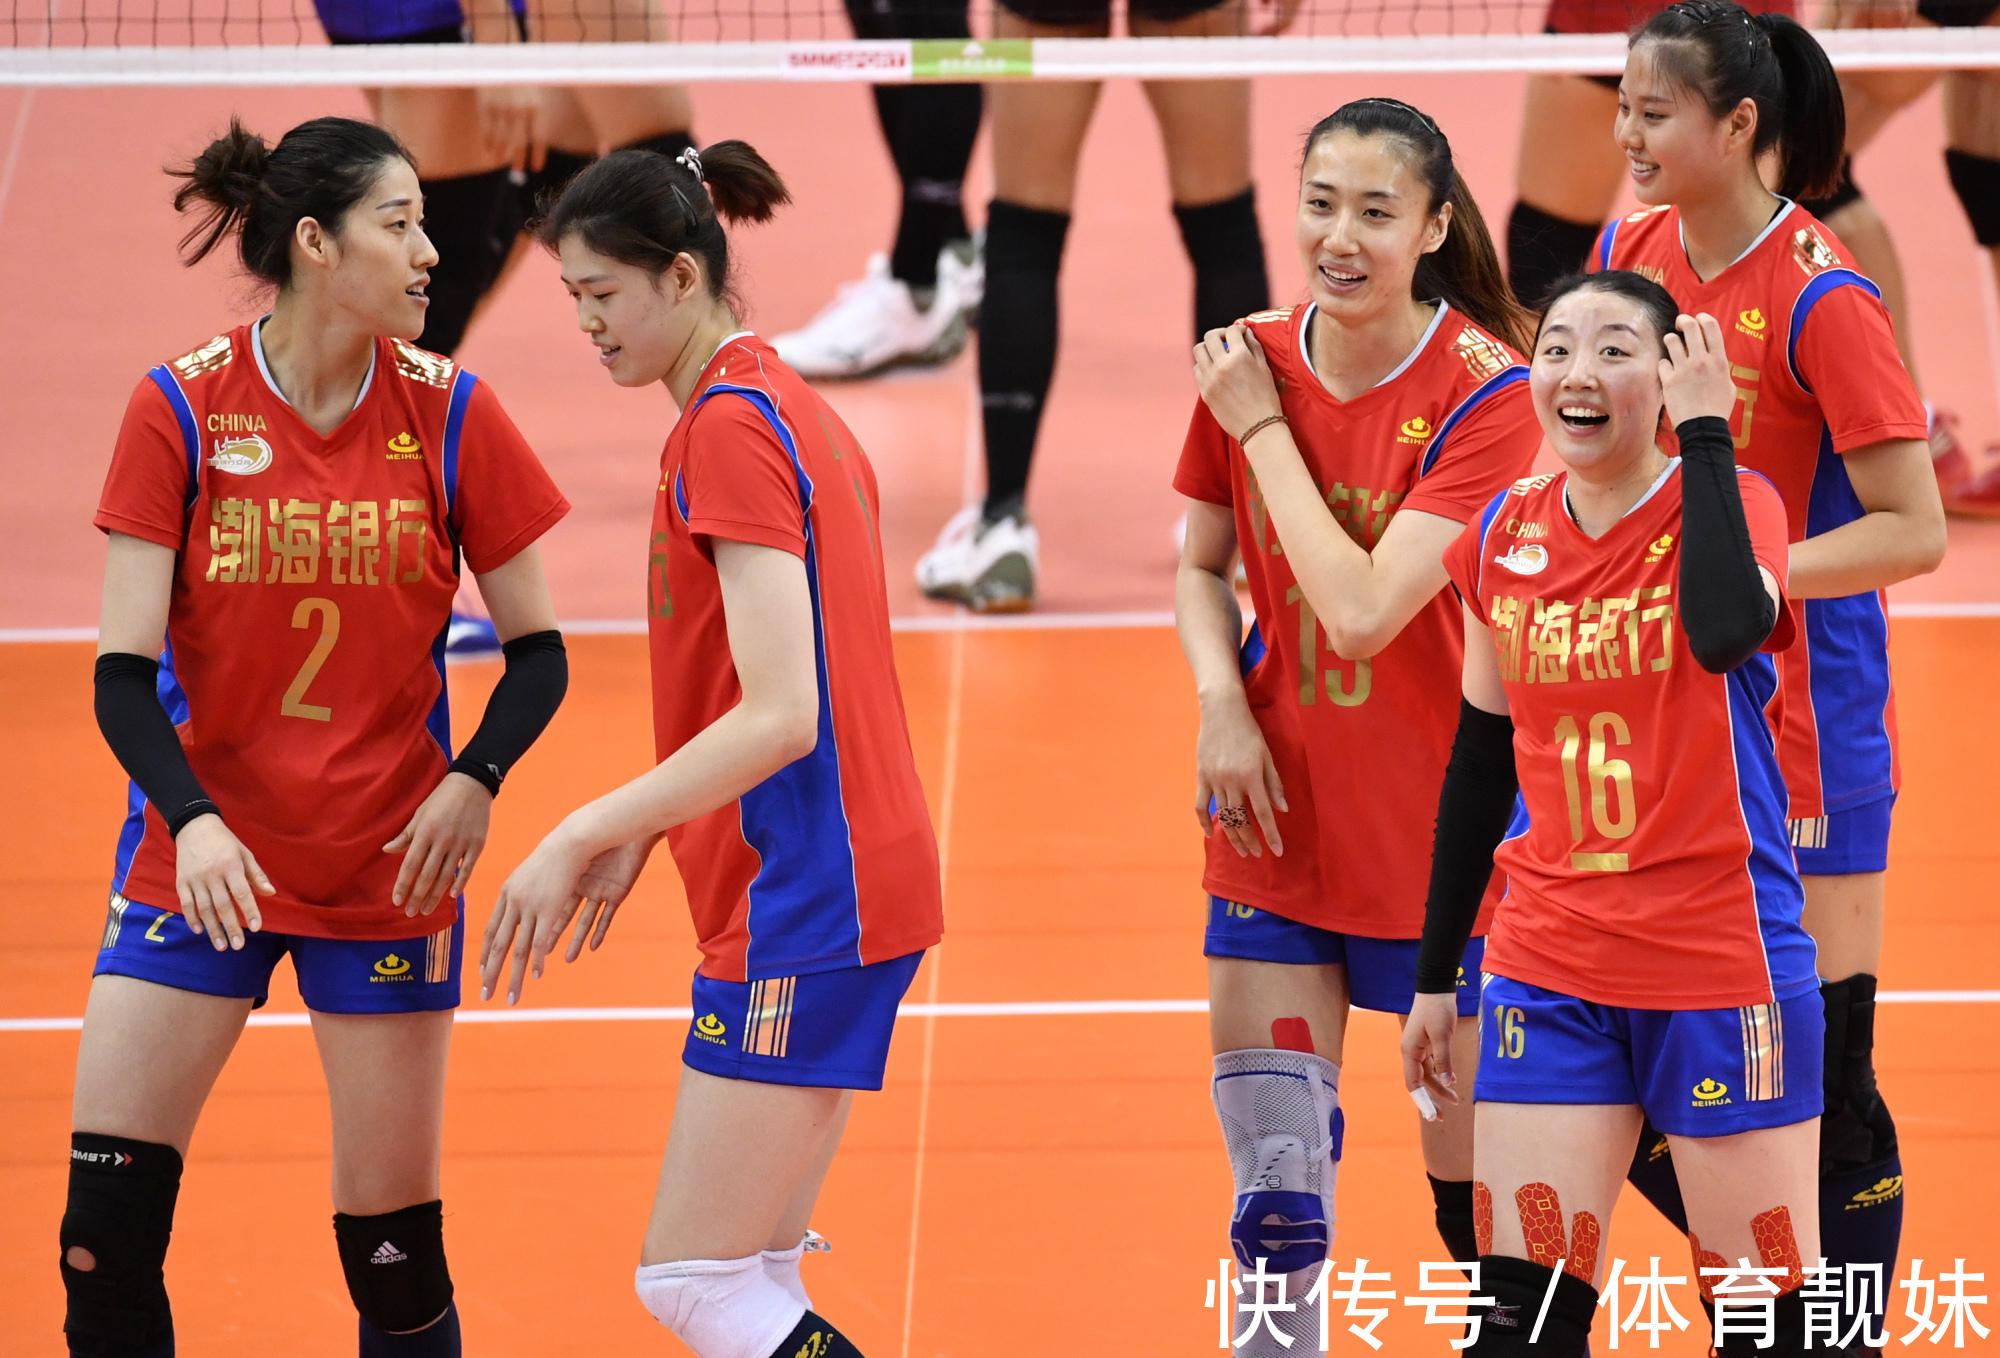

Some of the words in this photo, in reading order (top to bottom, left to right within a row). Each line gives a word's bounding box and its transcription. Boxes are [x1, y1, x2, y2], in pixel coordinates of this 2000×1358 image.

[1735, 322, 1764, 342] MEIHUA
[207, 414, 267, 432] CHINA
[1506, 518, 1548, 538] CHINA
[206, 498, 427, 586] 渤海银行
[1491, 584, 1673, 684] 渤海银行
[281, 597, 341, 722] 2
[1554, 711, 1637, 841] 16
[369, 975, 414, 983] MEIHUA
[693, 1030, 727, 1046] MEIHUA
[1493, 1004, 1525, 1059] 16
[1691, 1097, 1732, 1108] MEIHUA
[370, 1252, 407, 1265] adidas
